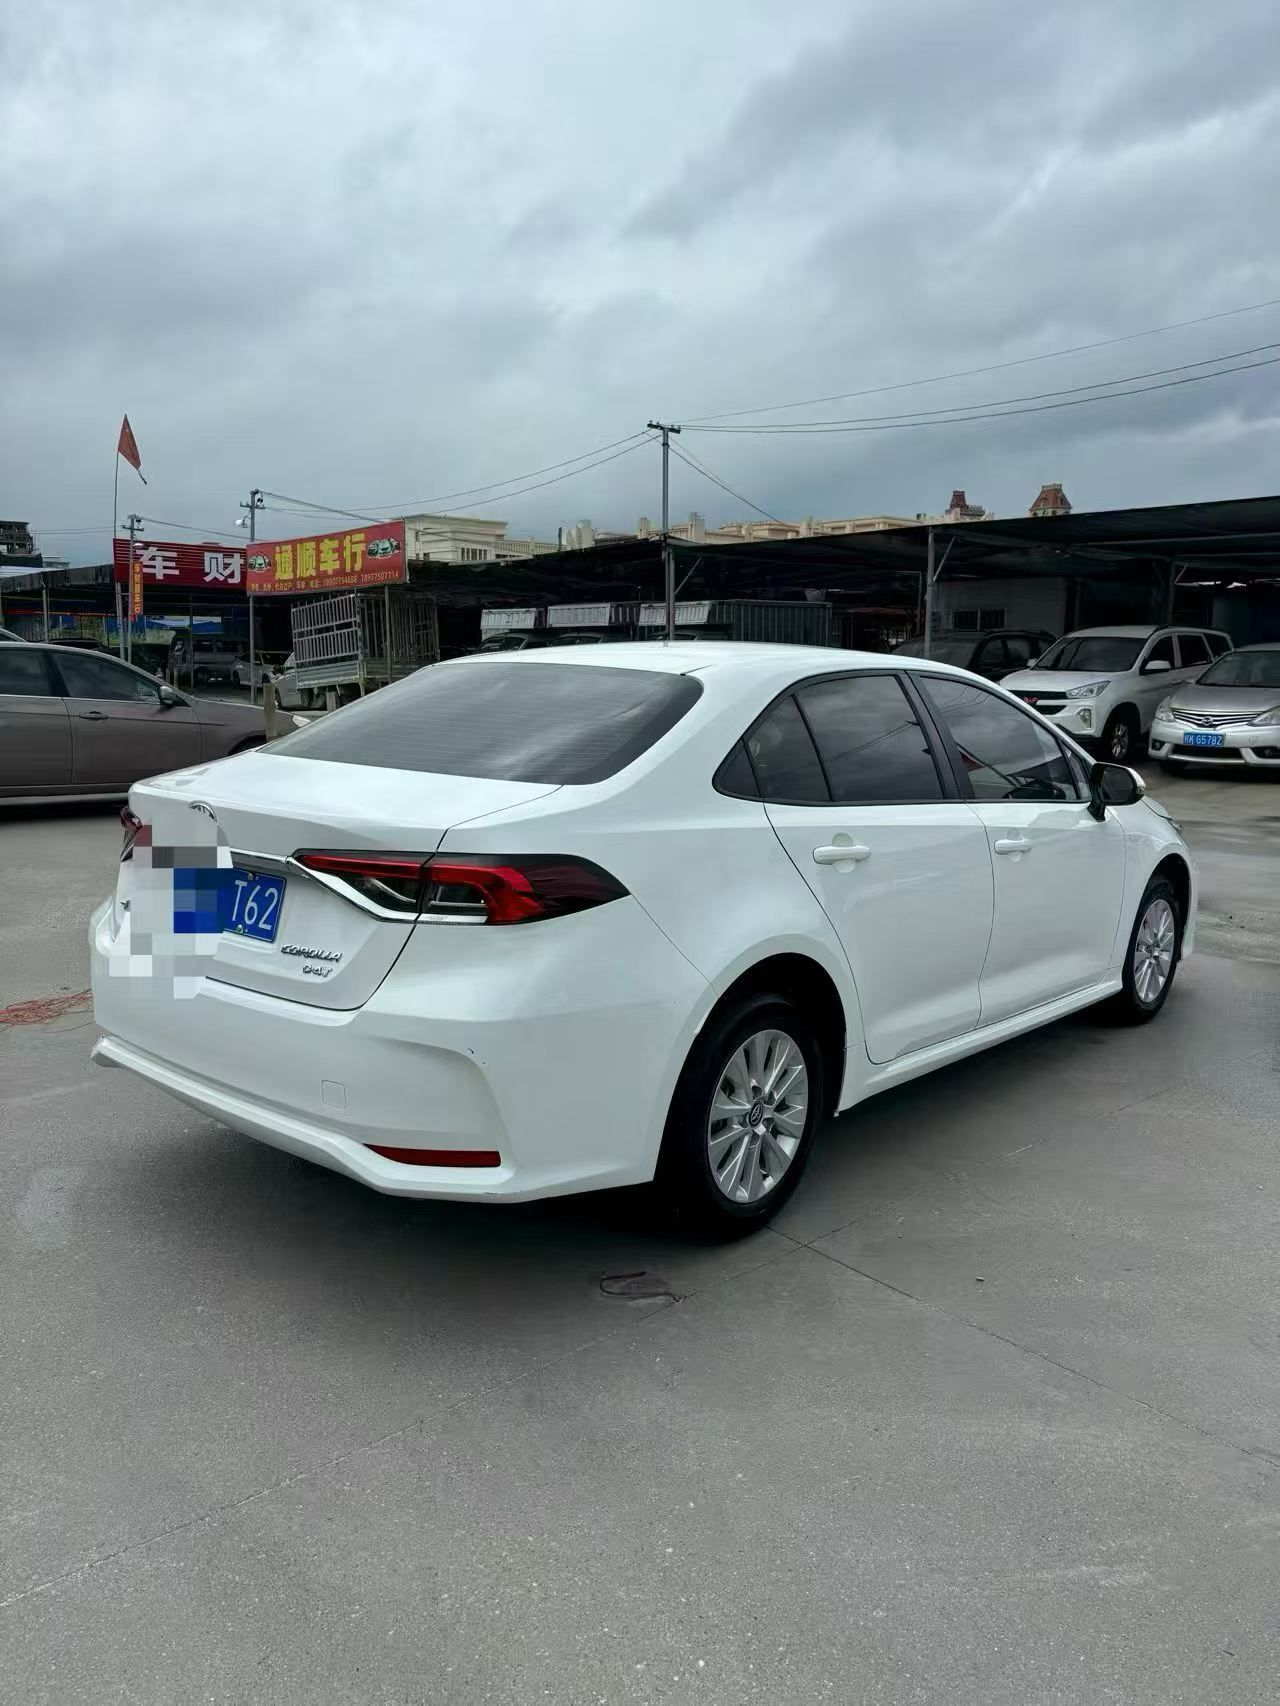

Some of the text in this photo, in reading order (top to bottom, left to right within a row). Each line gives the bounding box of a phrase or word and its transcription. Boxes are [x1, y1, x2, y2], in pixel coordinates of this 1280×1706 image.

[274, 533, 366, 580] 通顺车行
[281, 944, 343, 962] COROLLA
